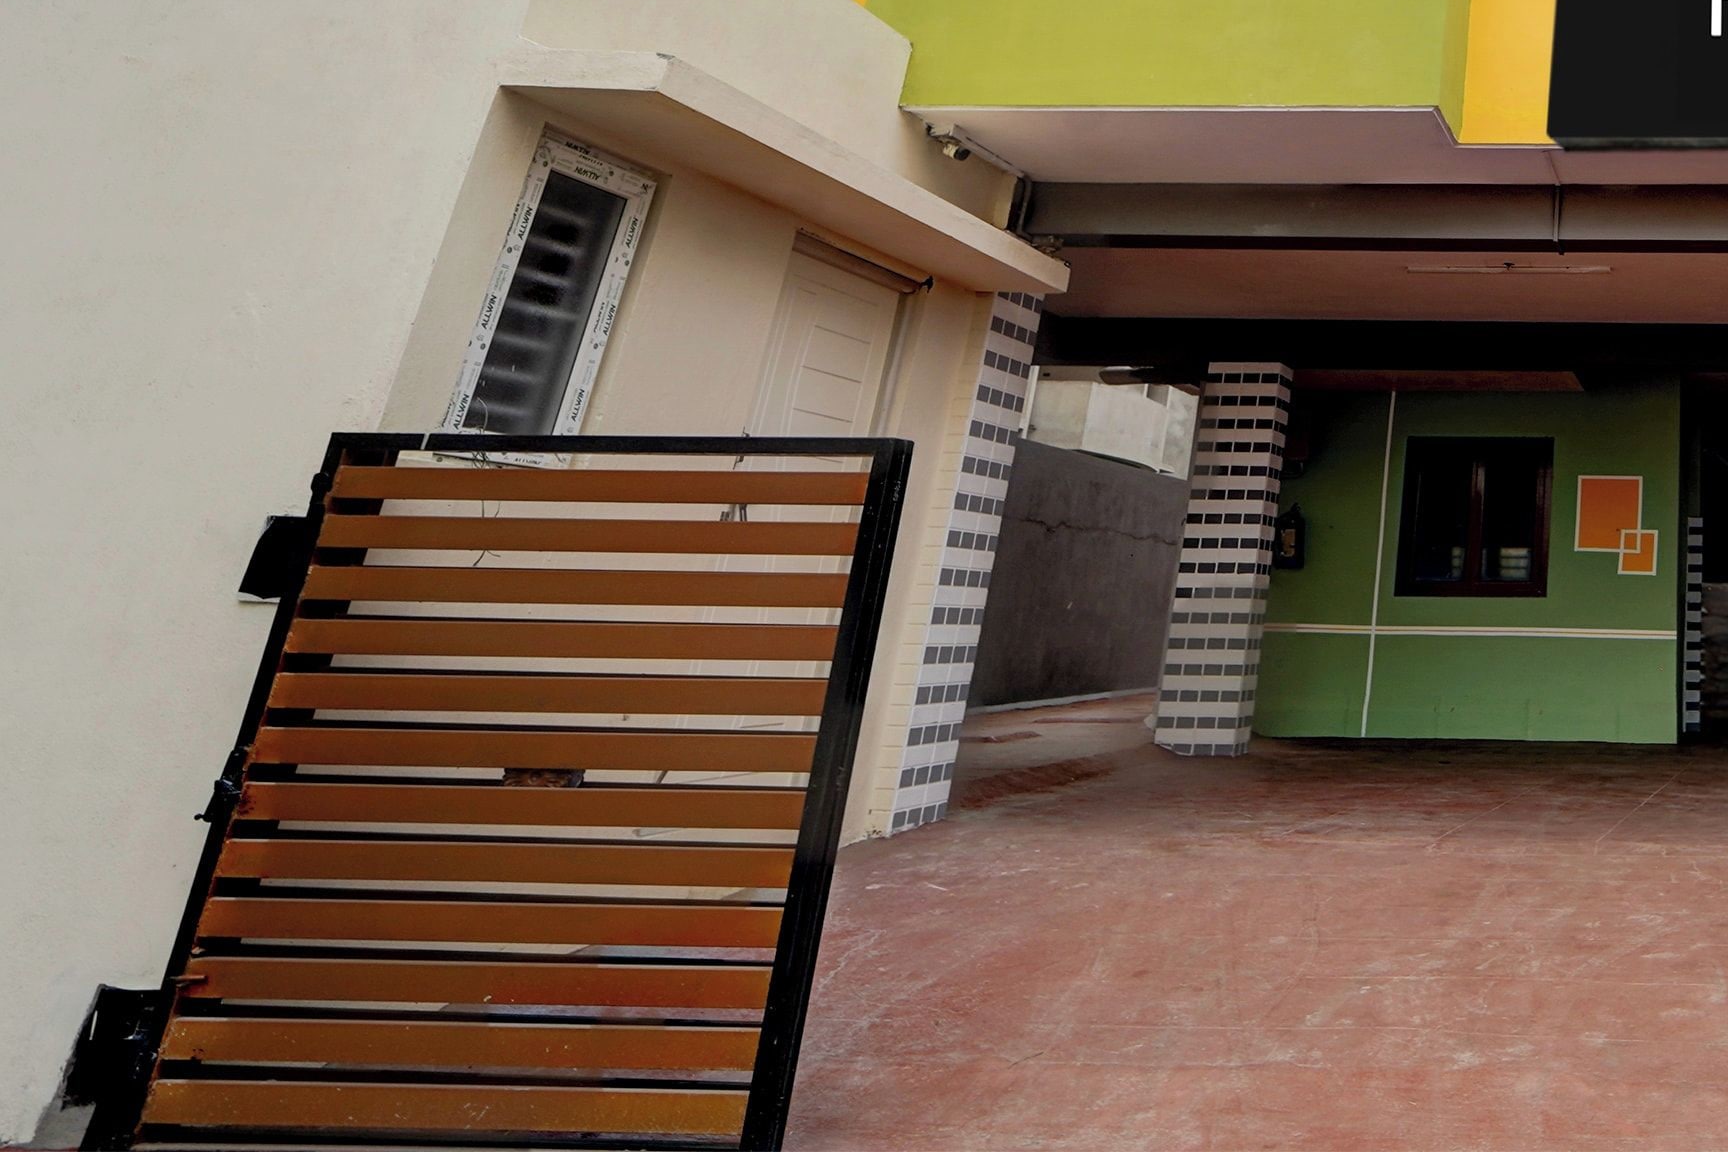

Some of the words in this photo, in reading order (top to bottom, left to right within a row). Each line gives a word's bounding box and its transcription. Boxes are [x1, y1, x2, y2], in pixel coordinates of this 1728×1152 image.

[517, 206, 533, 241] ALLWIN
[625, 216, 639, 249] ALLWIN
[481, 294, 497, 330] ALLWIN
[603, 303, 616, 336] ALLWIN
[453, 393, 470, 430] ALLWIN
[571, 388, 585, 422] ALLWIN
